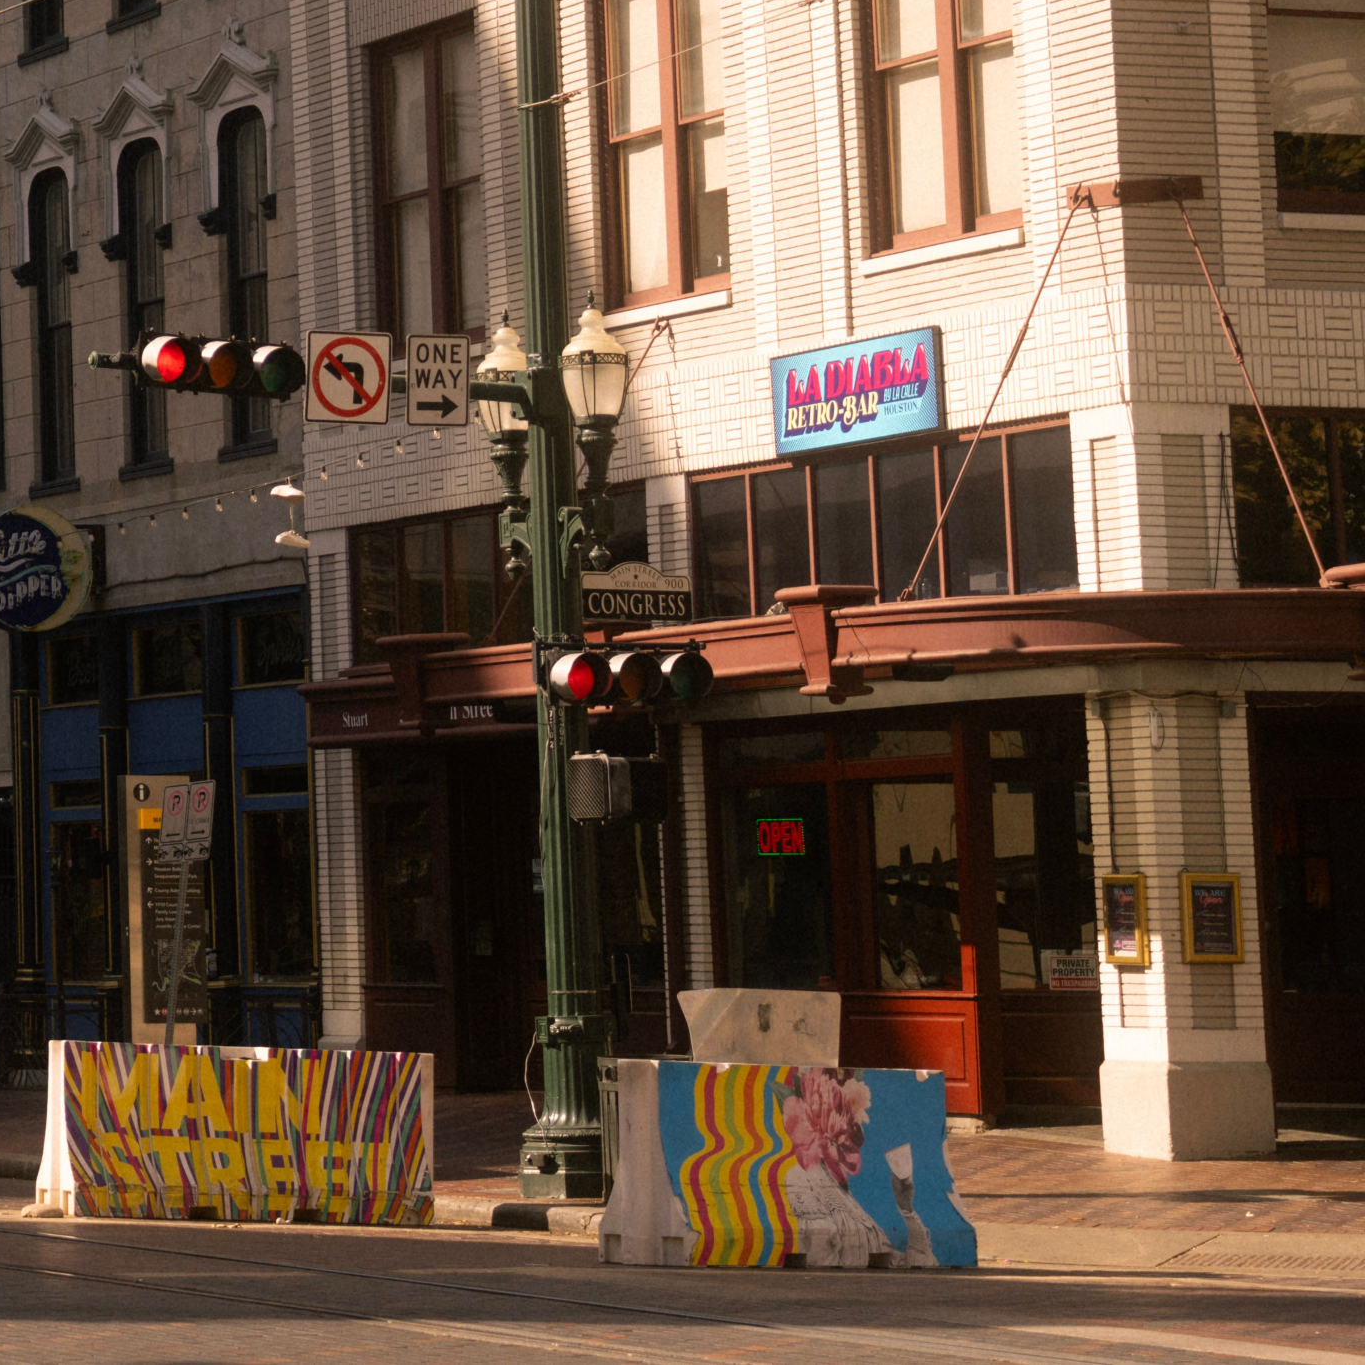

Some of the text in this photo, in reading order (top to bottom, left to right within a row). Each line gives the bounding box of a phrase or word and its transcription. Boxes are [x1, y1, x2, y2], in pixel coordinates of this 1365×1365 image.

[416, 343, 462, 363] ONE
[415, 368, 463, 389] WAY
[786, 343, 929, 406] LA DIABLA
[786, 391, 879, 431] RETRO-BAR
[610, 565, 661, 581] MAIN STREET
[614, 579, 684, 590] CORRIDOR 900
[588, 592, 685, 616] CONGRESS
[342, 712, 368, 728] Stuart
[759, 821, 805, 853] OPEN
[1210, 889, 1226, 897] ARE
[1052, 968, 1095, 977] PROPERTY
[1056, 959, 1090, 968] PRIVATE
[77, 1050, 320, 1136] MAIN
[89, 1132, 391, 1223] STREET
